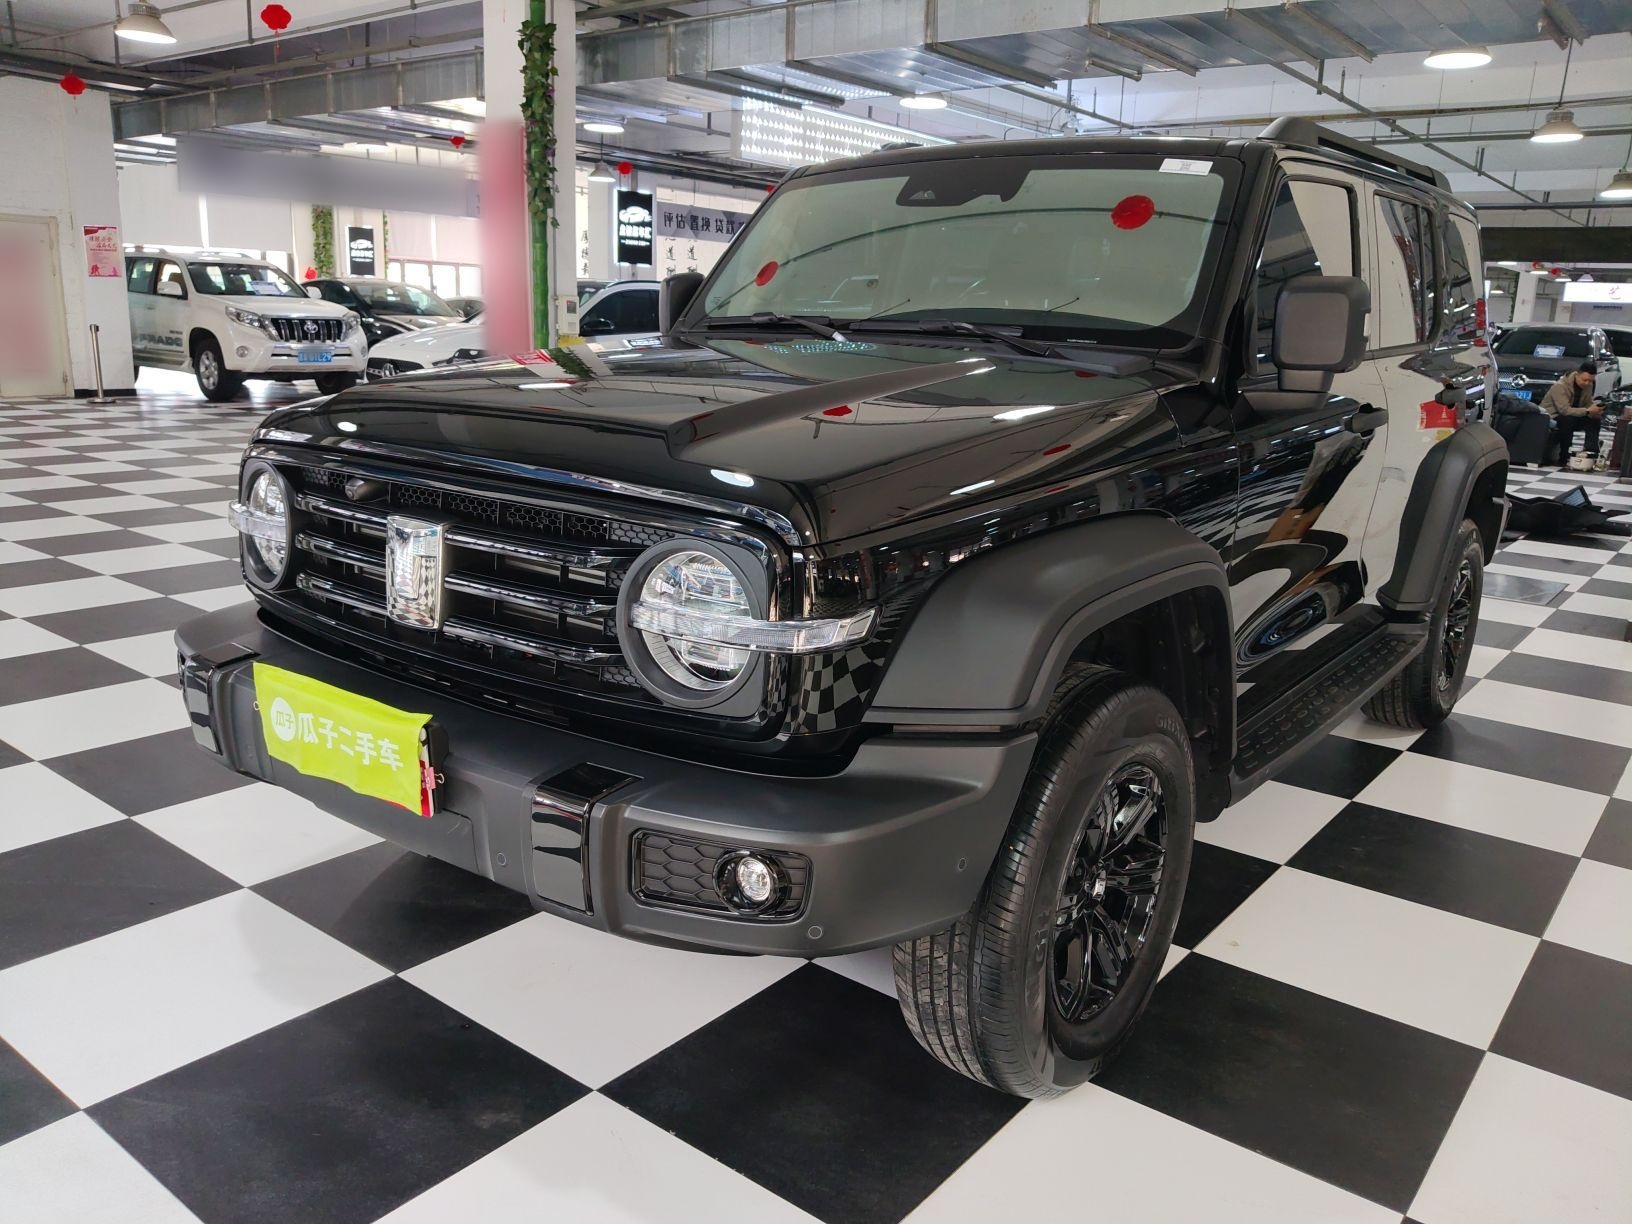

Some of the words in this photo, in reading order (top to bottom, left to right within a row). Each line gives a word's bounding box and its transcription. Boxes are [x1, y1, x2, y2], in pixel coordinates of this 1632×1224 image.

[664, 211, 686, 229] 评估
[689, 214, 711, 232] 置换
[275, 710, 294, 730] 瓜子
[298, 712, 404, 771] 瓜子二手车
